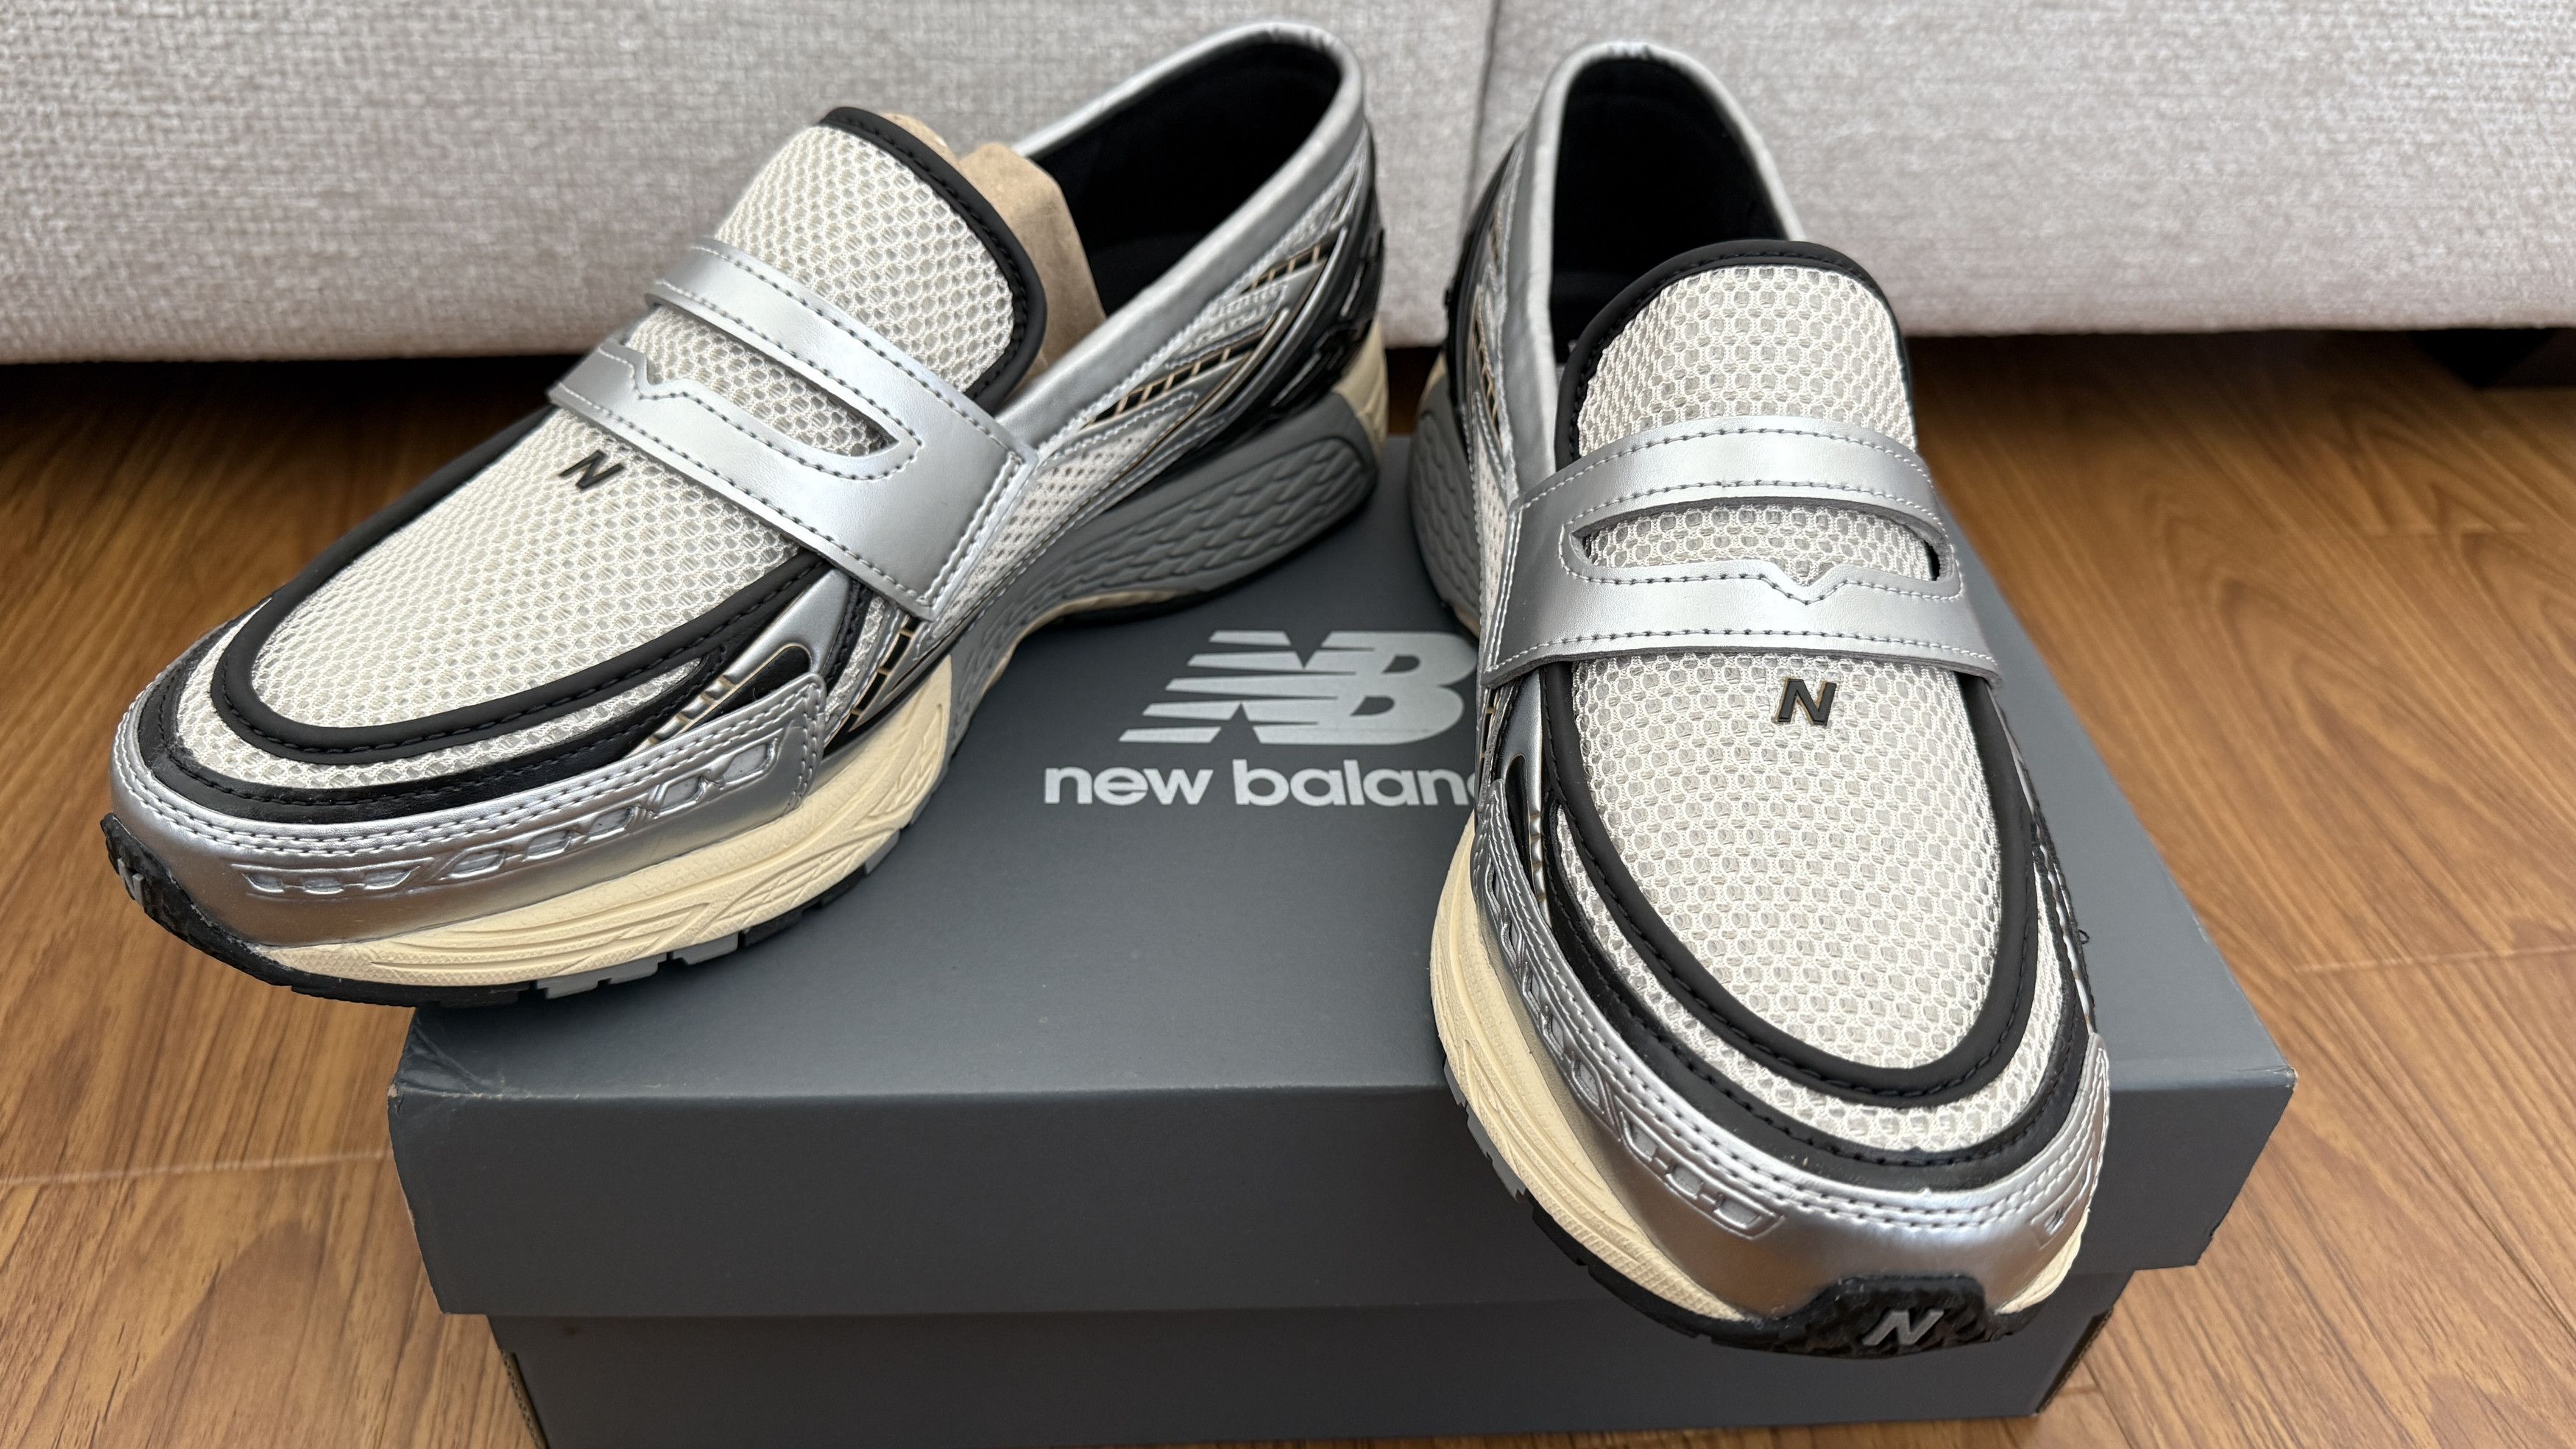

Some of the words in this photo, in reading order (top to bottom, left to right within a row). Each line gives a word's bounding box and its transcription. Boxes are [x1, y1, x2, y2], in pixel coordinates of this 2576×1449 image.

[559, 449, 625, 489] N
[1119, 630, 1479, 745] NB
[1775, 678, 1837, 726] N
[1044, 766, 1214, 804] new
[1233, 759, 1476, 807] balan
[1862, 1308, 1944, 1345] N
